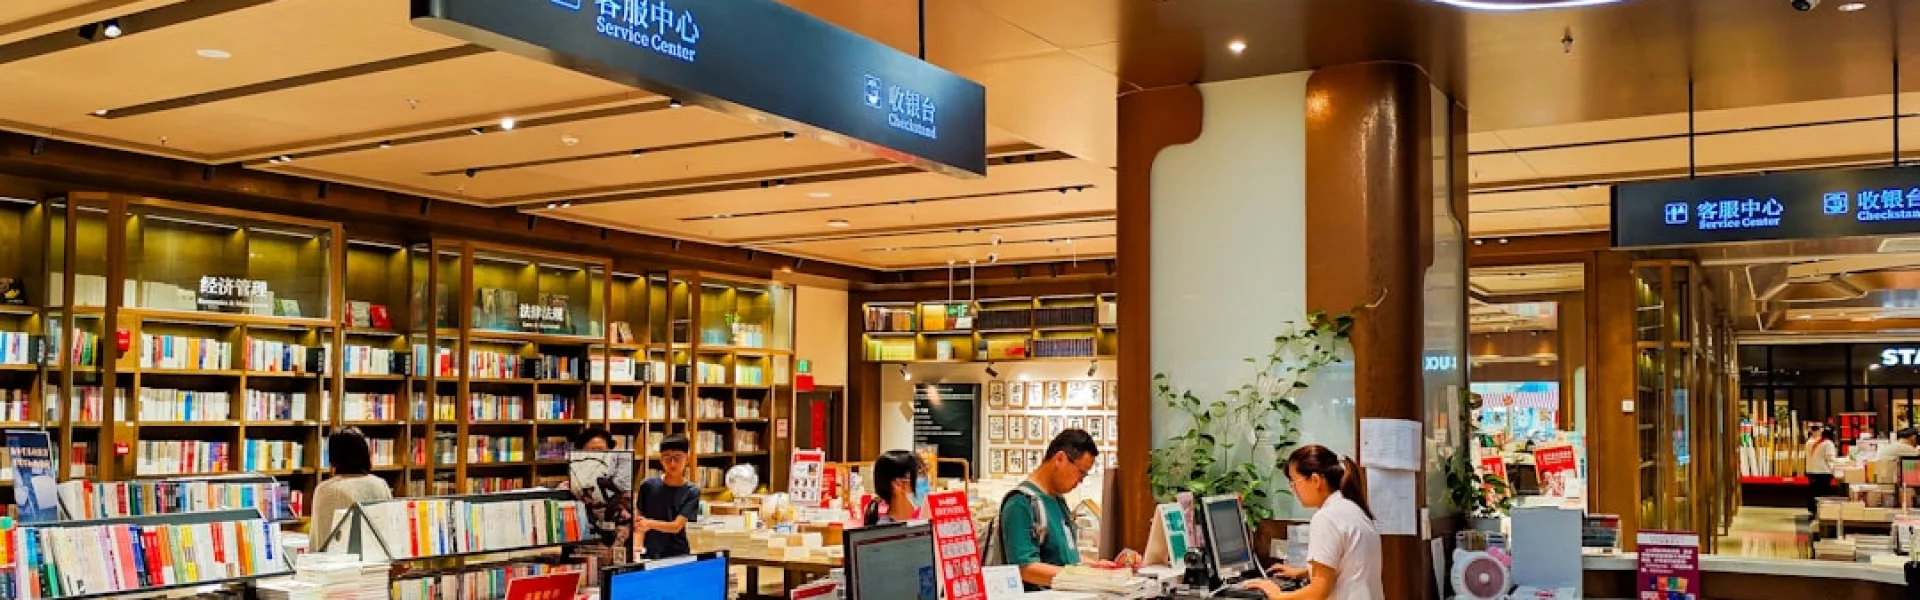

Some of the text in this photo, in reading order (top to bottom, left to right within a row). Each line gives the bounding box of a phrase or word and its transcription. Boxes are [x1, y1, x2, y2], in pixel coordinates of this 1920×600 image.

[596, 15, 696, 62] Service Center
[888, 85, 936, 124] 收银台
[1697, 197, 1784, 220] 客服中心
[1698, 217, 1780, 230] Service Center
